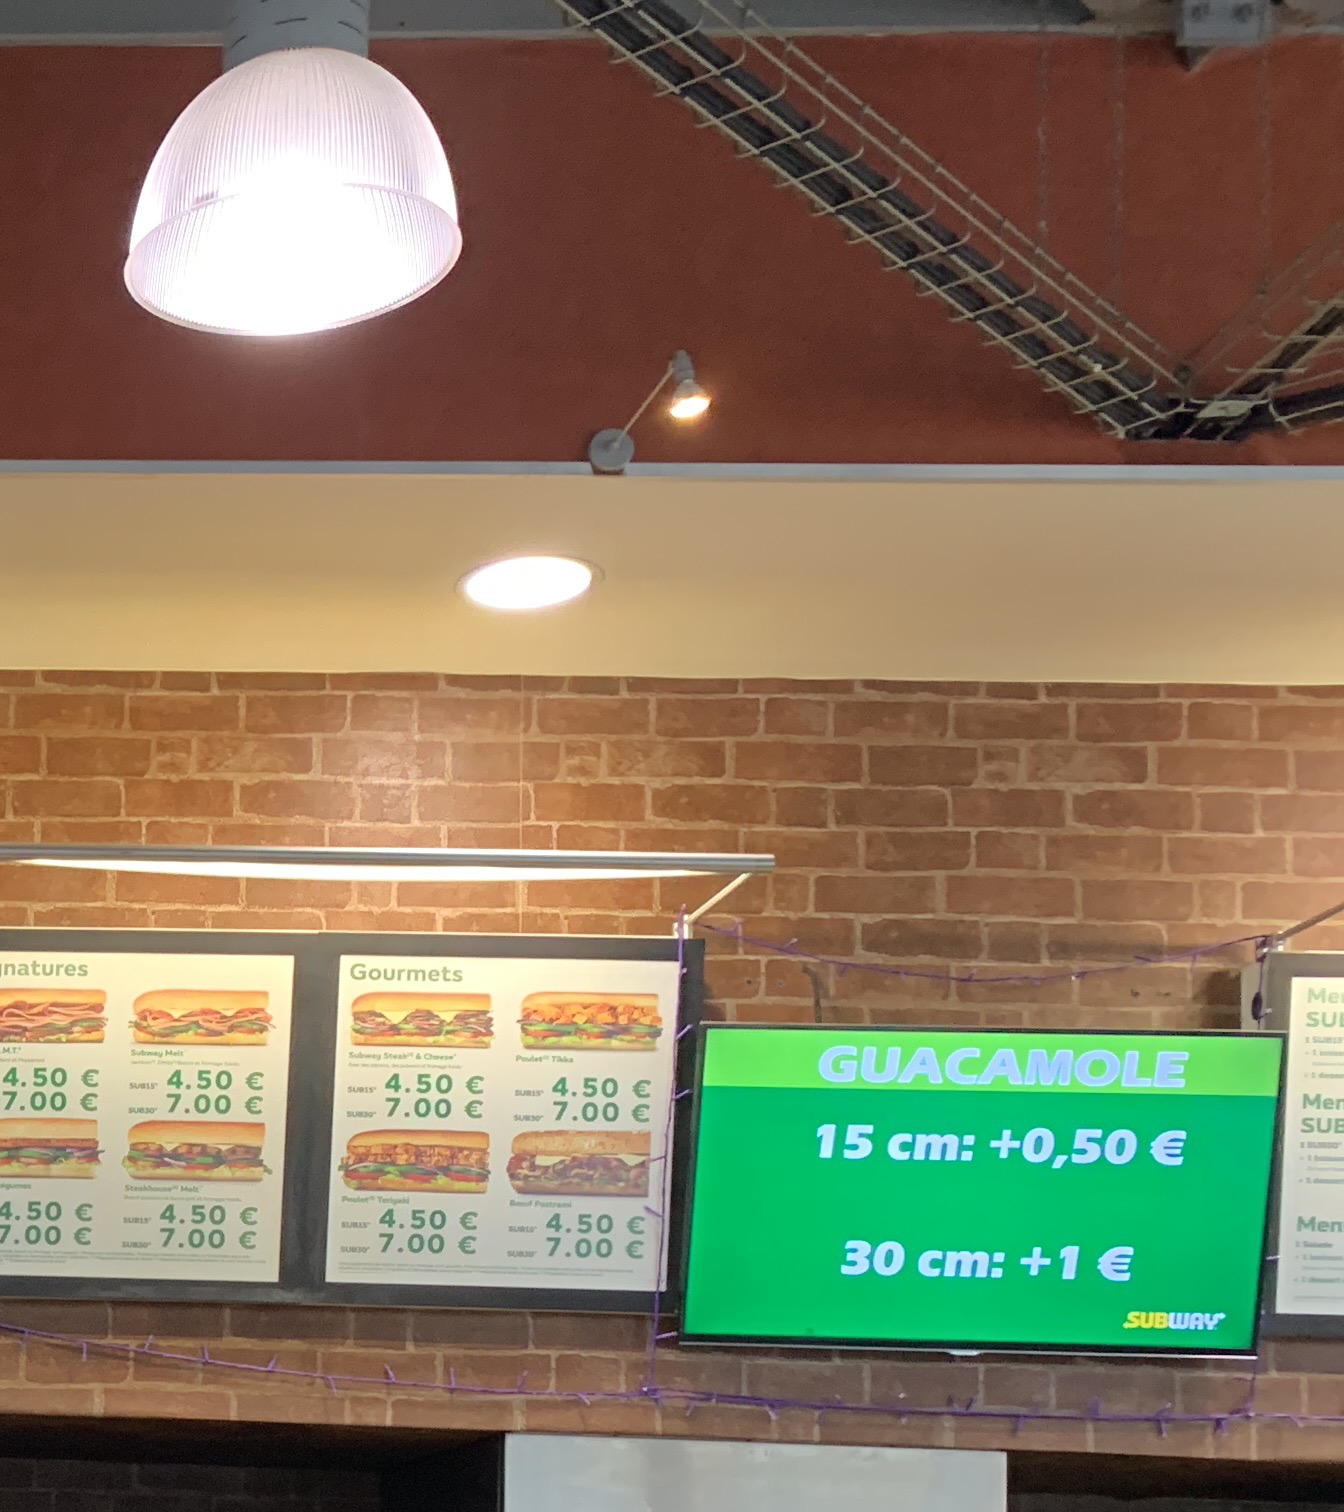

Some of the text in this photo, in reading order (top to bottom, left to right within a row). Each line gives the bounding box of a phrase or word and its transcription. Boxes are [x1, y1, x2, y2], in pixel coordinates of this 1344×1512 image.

[350, 963, 463, 982] Gourmets
[1307, 987, 1344, 1004] Me
[131, 1049, 163, 1058] Subway
[348, 1051, 381, 1060] Subway
[2, 1067, 67, 1088] 4.50
[81, 1069, 99, 1088] €
[819, 1045, 1190, 1088] GUACAMOLE
[166, 1069, 232, 1090] 4.50
[245, 1071, 264, 1091] €
[385, 1073, 453, 1094] 4.50
[465, 1075, 484, 1094] €
[552, 1077, 651, 1098] 4.50 €
[2, 1091, 67, 1112] 7.00
[80, 1093, 98, 1112] €
[166, 1093, 263, 1115] 7.00 €
[385, 1097, 483, 1119] 7.00 €
[553, 1101, 650, 1123] 7.00 €
[816, 1123, 1187, 1169] 15 cm: +0,50 €
[74, 1203, 93, 1222] €
[159, 1204, 258, 1226] 4.50 €
[379, 1208, 478, 1231] 4.50 €
[546, 1213, 645, 1235] 4.50 €
[1296, 1215, 1344, 1233] Men
[73, 1227, 92, 1245] €
[160, 1228, 257, 1250] 7.00 €
[378, 1232, 477, 1255] 7.00 €
[546, 1237, 645, 1259] 7.00 €
[840, 1240, 1134, 1282] 30 cm: +1 €
[1122, 1310, 1226, 1331] SUBWAY
